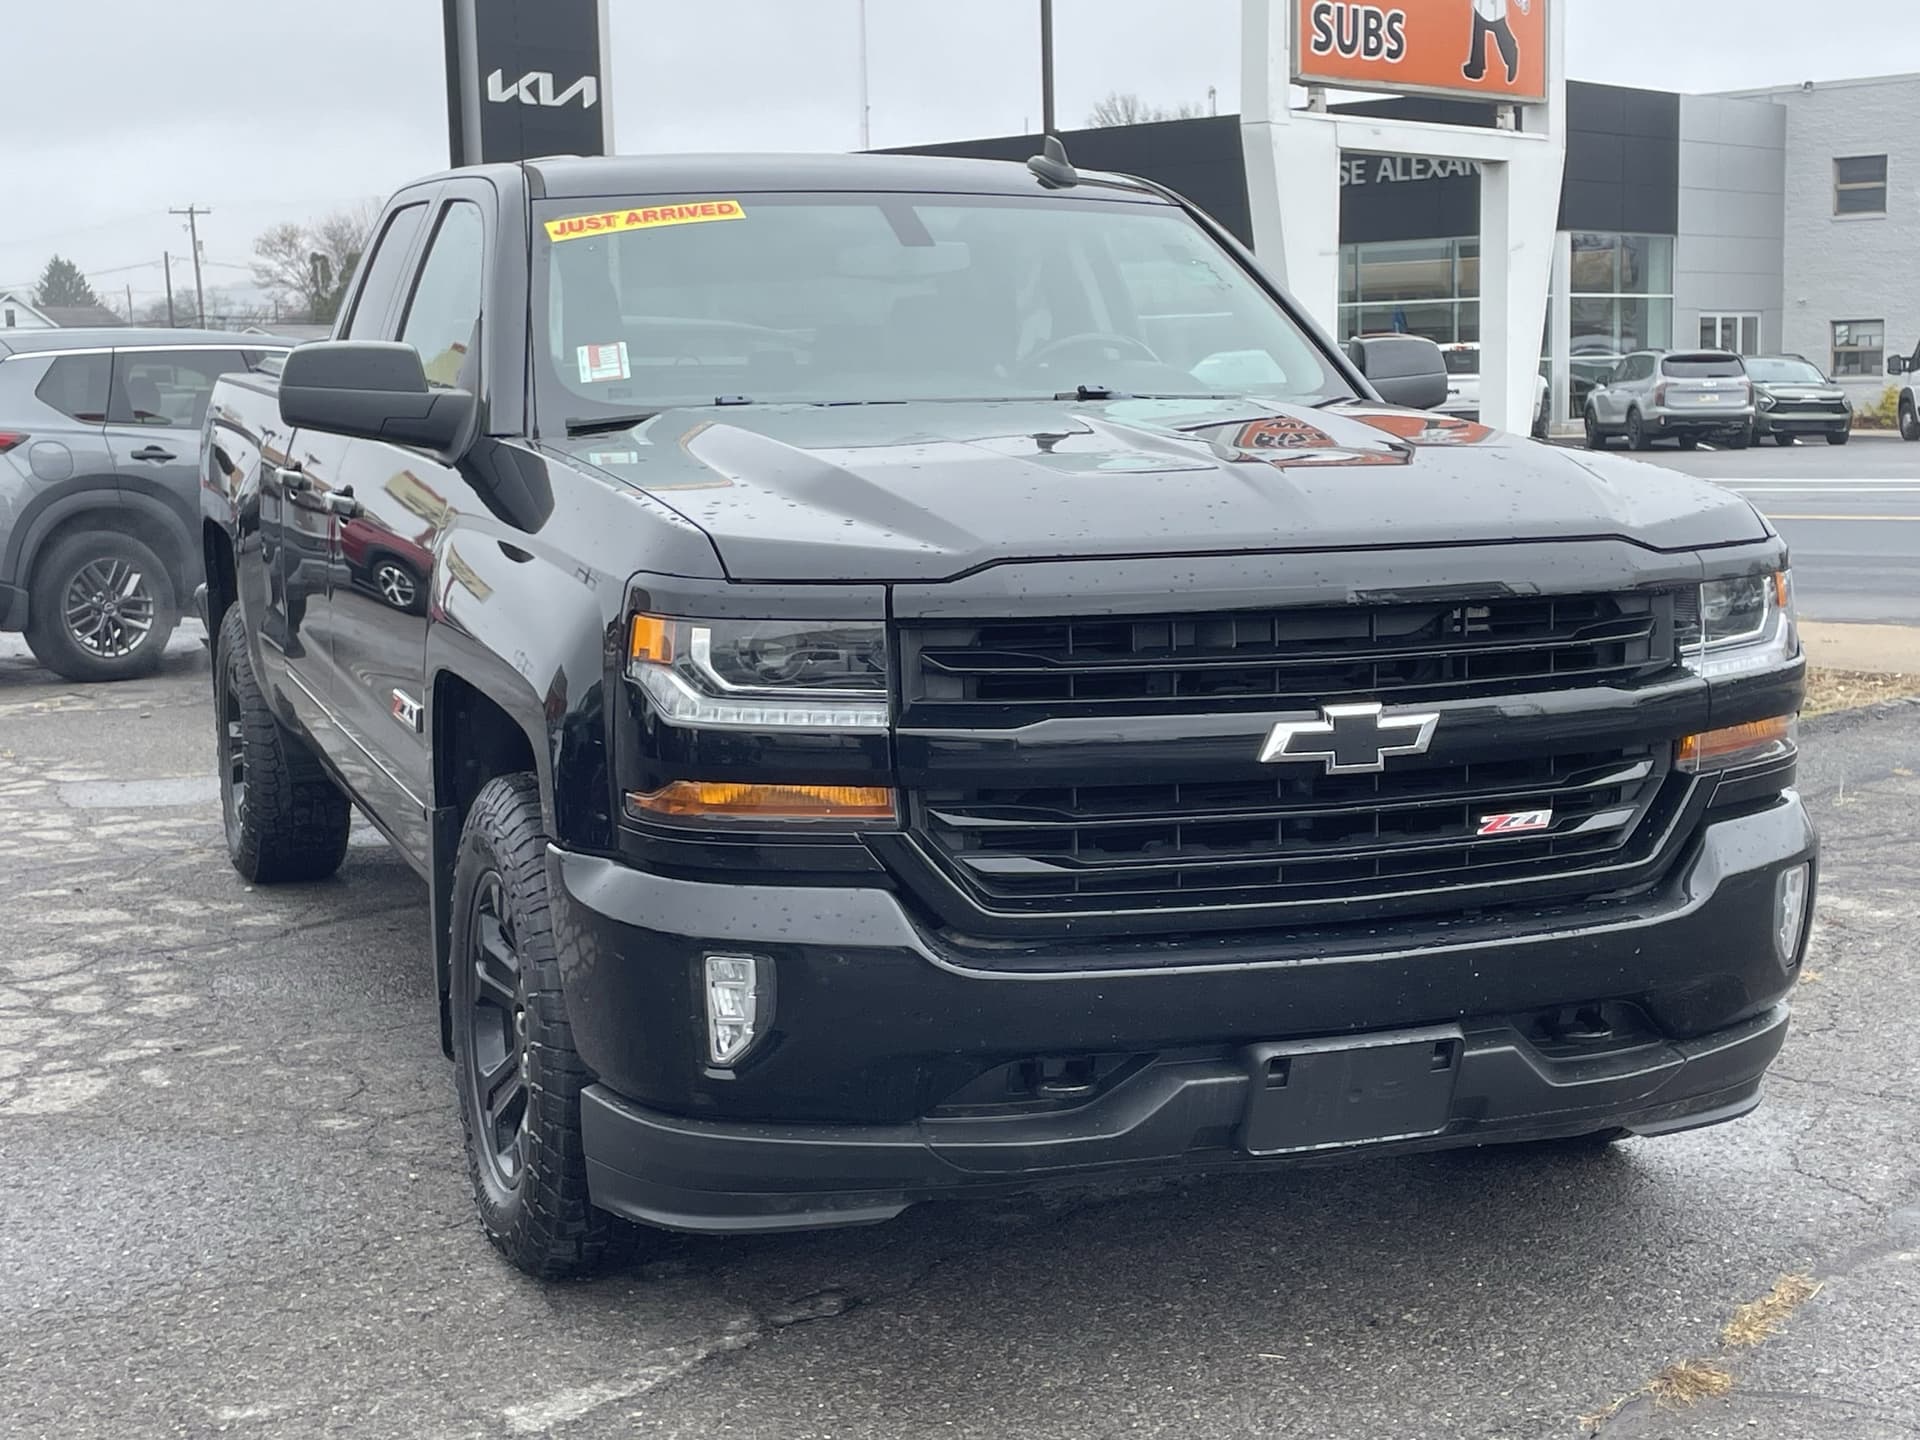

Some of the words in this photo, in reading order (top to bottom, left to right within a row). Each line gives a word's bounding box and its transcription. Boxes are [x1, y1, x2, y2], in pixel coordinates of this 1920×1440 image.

[1311, 2, 1405, 62] SUBS
[487, 69, 598, 109] KIA
[553, 214, 618, 236] JUST
[625, 203, 735, 225] ARRIVED
[1477, 809, 1552, 835] Z71
